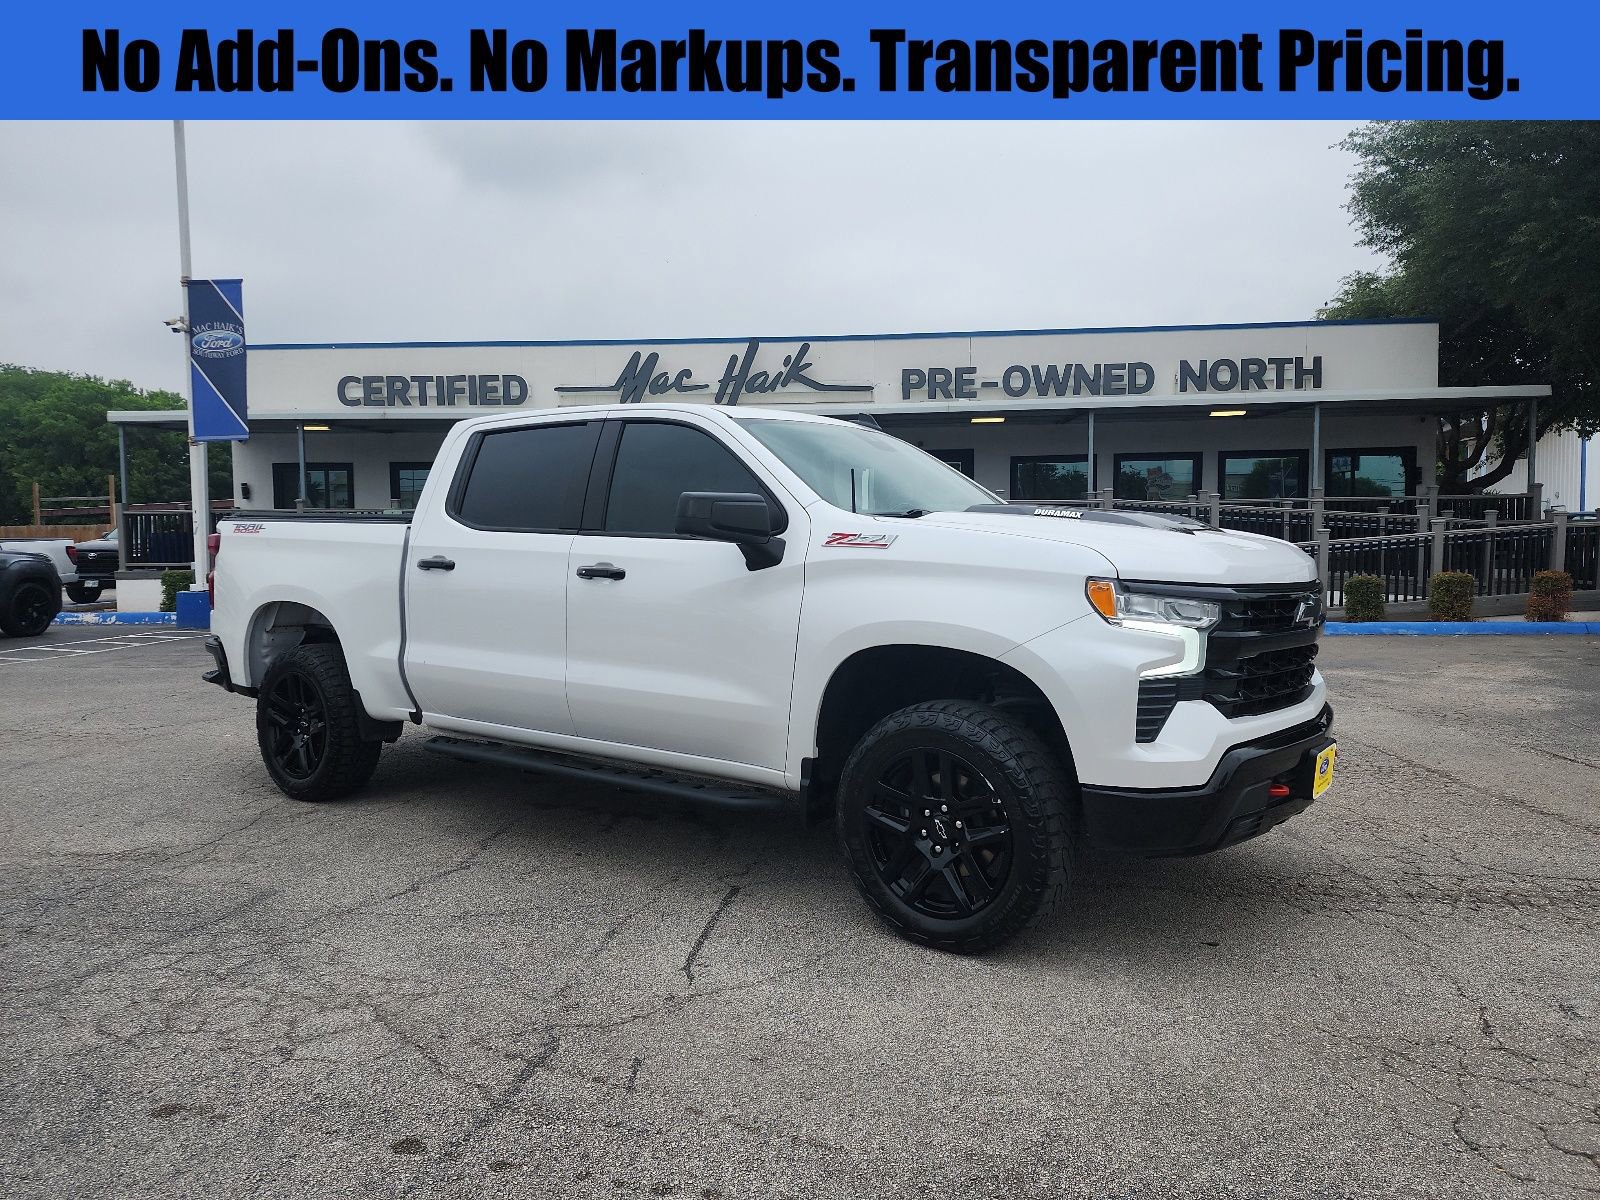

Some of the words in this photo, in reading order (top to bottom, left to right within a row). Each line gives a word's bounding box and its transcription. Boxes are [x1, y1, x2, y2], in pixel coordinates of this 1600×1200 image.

[192, 322, 212, 334] MAC
[213, 321, 244, 335] HAIK'S
[201, 335, 233, 348] Ford
[226, 347, 244, 358] FORD
[337, 374, 529, 407] CERTIFIED
[612, 351, 710, 403] Mac
[713, 338, 822, 406] Haik
[901, 361, 1155, 400] PRE-OWNED
[1179, 355, 1323, 393] NORTH
[1033, 508, 1083, 519] DURAMAX
